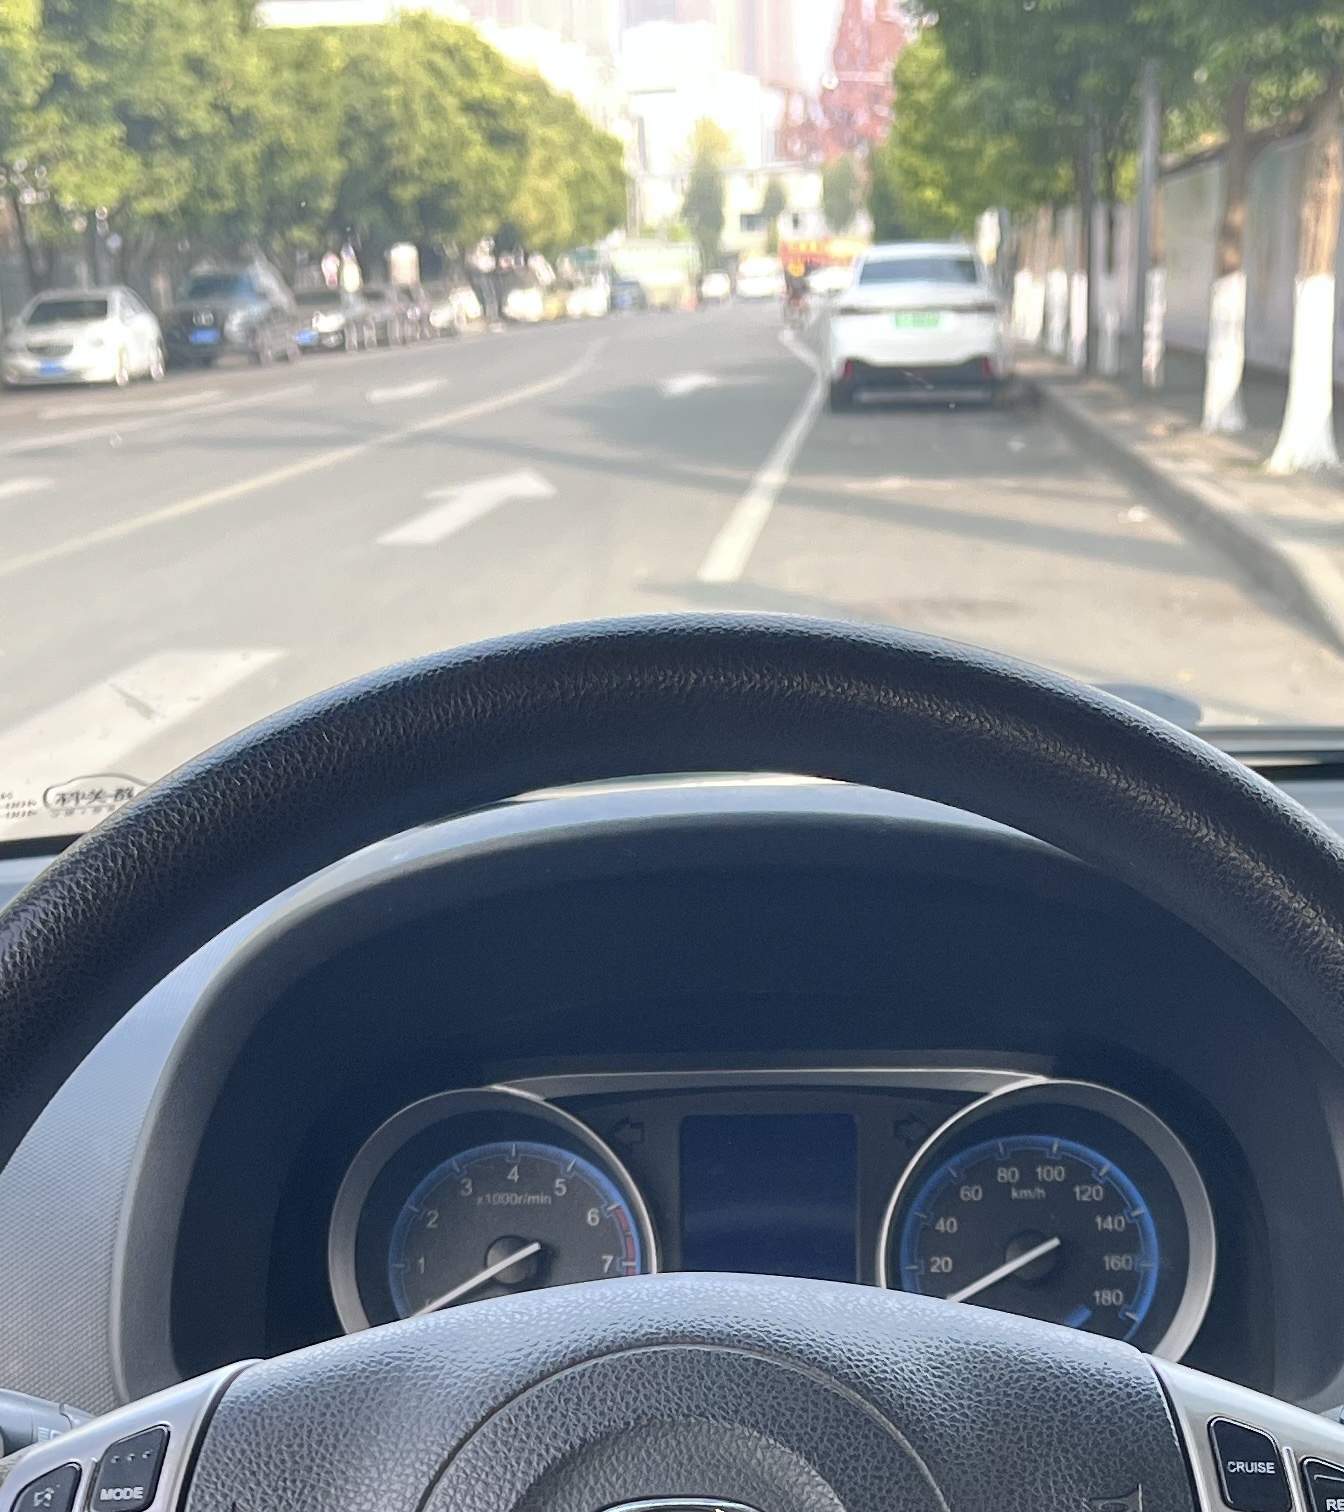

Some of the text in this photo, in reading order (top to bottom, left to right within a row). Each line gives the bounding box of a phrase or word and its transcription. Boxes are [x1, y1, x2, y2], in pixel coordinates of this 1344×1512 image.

[507, 1165, 519, 1183] 4
[997, 1167, 1020, 1183] 80
[1036, 1165, 1065, 1182] 100
[461, 1179, 473, 1197] 3
[555, 1178, 567, 1197] 5
[960, 1185, 983, 1201] 60
[1011, 1186, 1046, 1200] km/h
[1074, 1185, 1104, 1201] 120
[426, 1210, 439, 1228] 2
[587, 1208, 600, 1226] 6
[935, 1217, 958, 1233] 40
[1096, 1215, 1126, 1232] 140
[417, 1256, 426, 1274] 1
[602, 1255, 614, 1273] 7
[930, 1256, 953, 1273] 20
[1103, 1254, 1133, 1271] 160
[1094, 1289, 1124, 1306] 180
[1227, 1461, 1275, 1475] CRUISE
[100, 1486, 144, 1501] MODE
